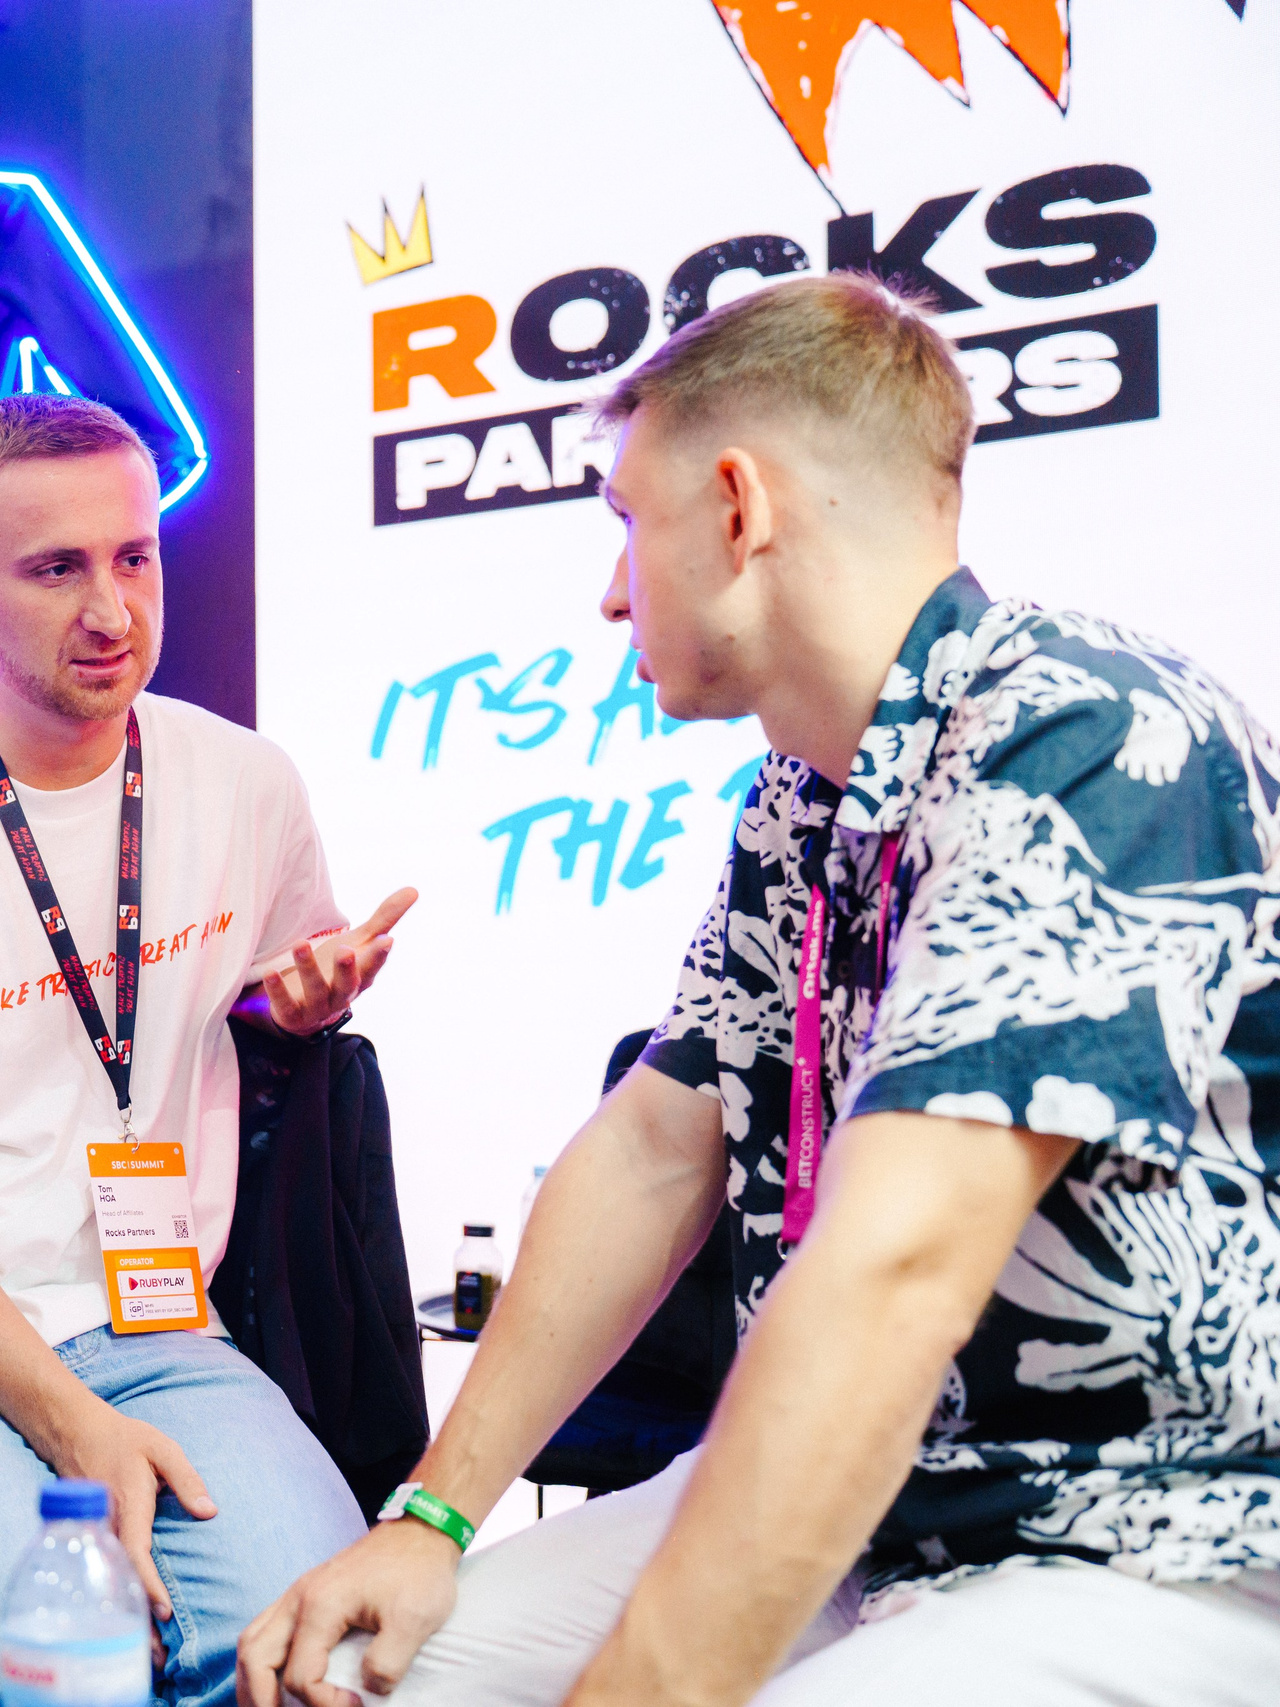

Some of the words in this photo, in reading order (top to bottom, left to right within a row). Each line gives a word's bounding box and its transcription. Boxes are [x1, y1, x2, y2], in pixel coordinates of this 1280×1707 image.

[122, 820, 131, 852] TRAFFIC
[20, 827, 34, 848] MAKE
[29, 850, 48, 881] TRAFFIC
[481, 781, 694, 915] THE
[120, 856, 129, 879] MAKE
[36, 952, 116, 1002] TRFIC
[140, 924, 197, 966] REAT
[70, 955, 84, 976] MAKE
[797, 1068, 815, 1189] BETCONSTRUCT
[111, 1160, 127, 1169] SBC
[131, 1160, 164, 1169] SUMMIT
[98, 1185, 113, 1193] Tom
[105, 1229, 125, 1237] Rocks
[127, 1228, 155, 1237] Partners
[119, 1258, 154, 1266] OPERATOR
[140, 1277, 184, 1288] RUBYPLAY
